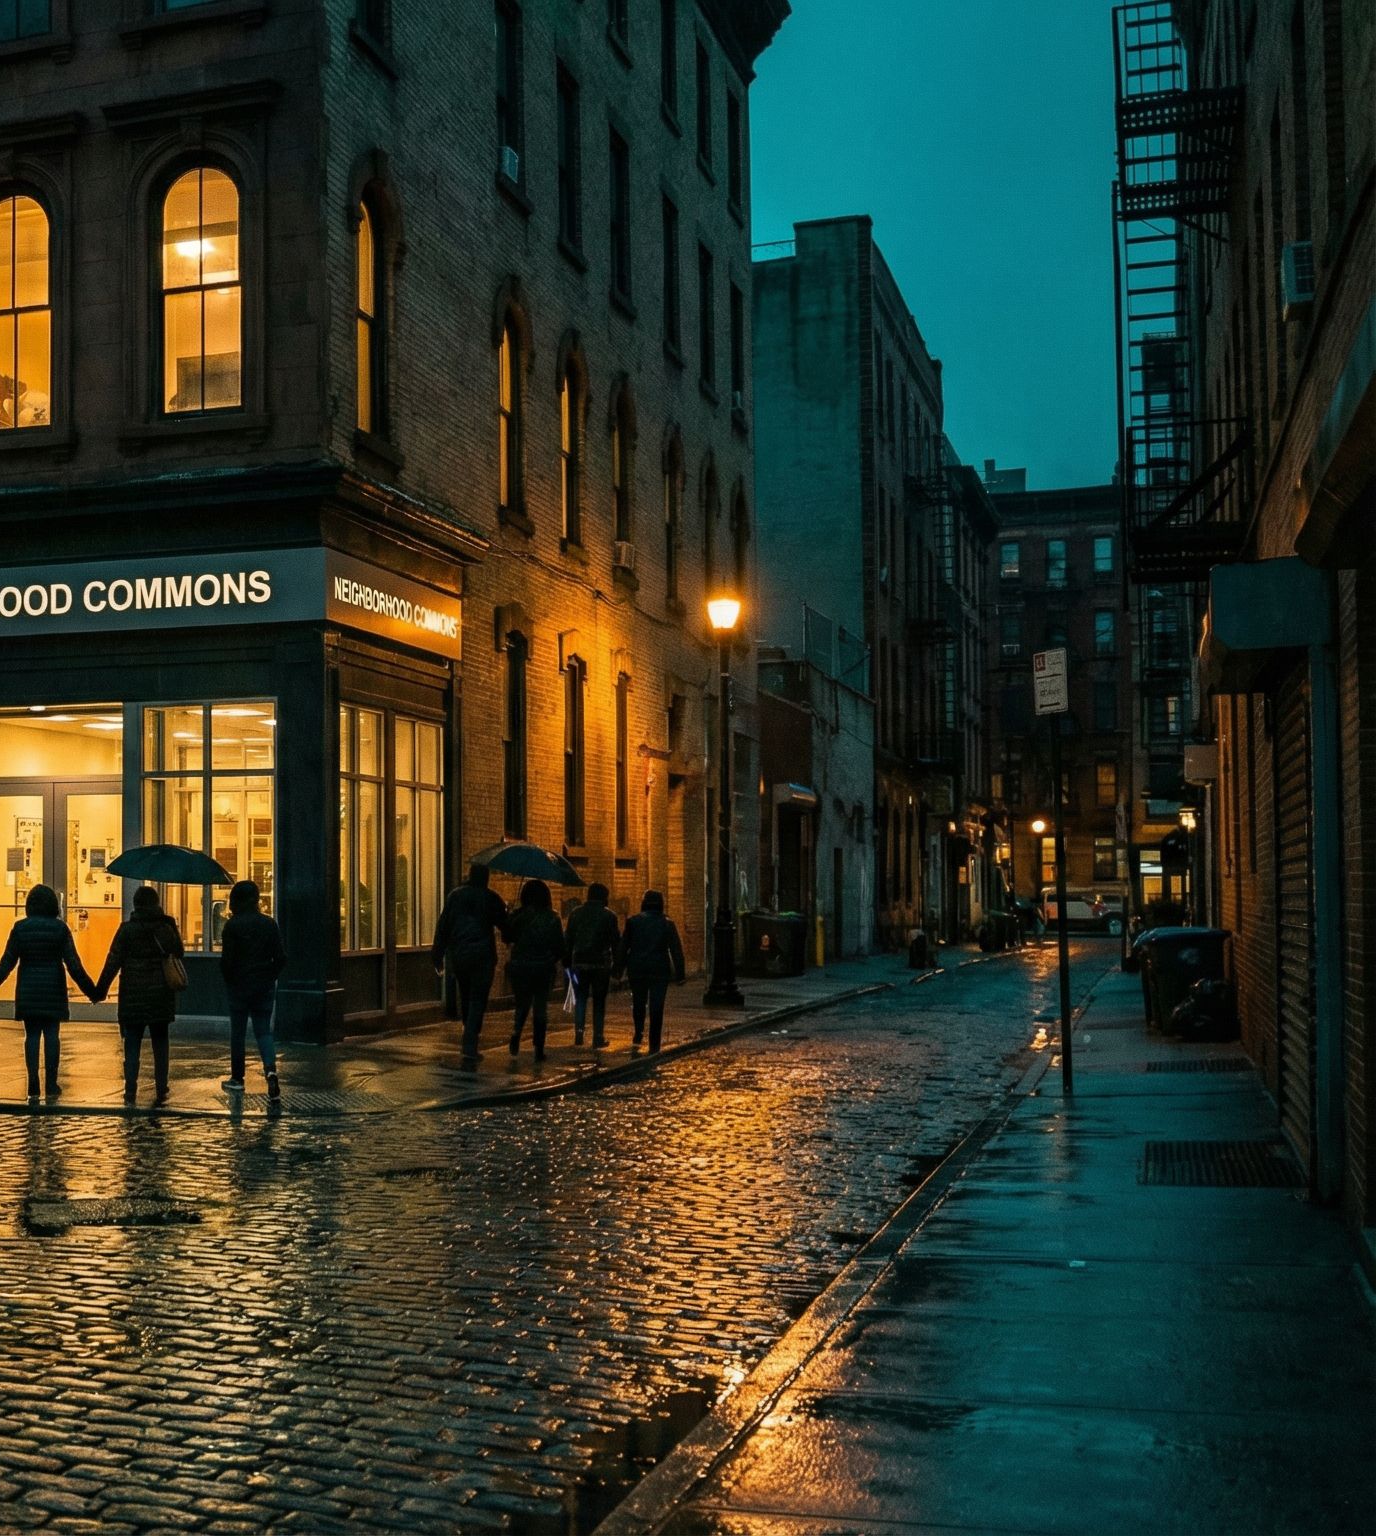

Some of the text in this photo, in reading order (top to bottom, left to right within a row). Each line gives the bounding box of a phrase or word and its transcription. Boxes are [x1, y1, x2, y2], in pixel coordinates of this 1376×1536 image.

[83, 570, 271, 613] COMMONS
[334, 576, 457, 639] NEIGHBORHOOD COMMONS
